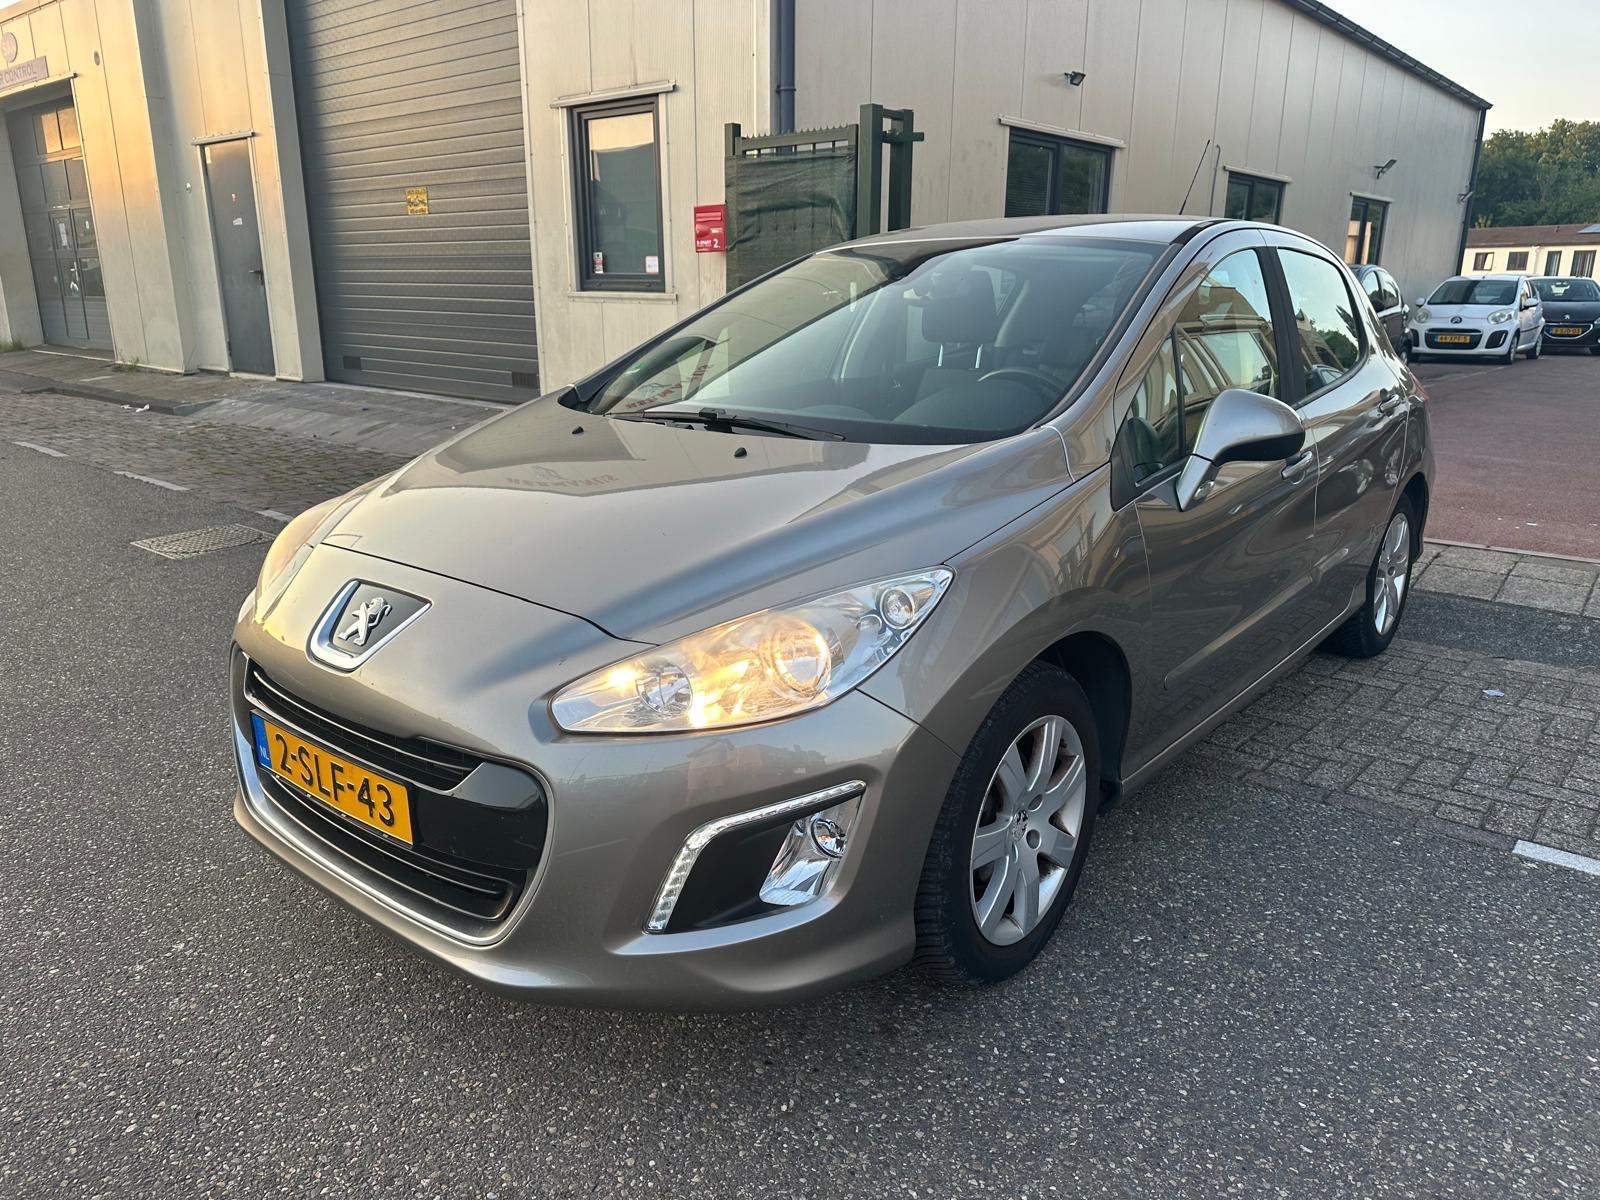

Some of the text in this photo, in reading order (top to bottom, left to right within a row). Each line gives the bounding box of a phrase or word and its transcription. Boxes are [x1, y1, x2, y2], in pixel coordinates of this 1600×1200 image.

[4, 63, 37, 83] CONTROL
[259, 746, 270, 760] NL
[275, 733, 395, 827] 2-SLF-43
